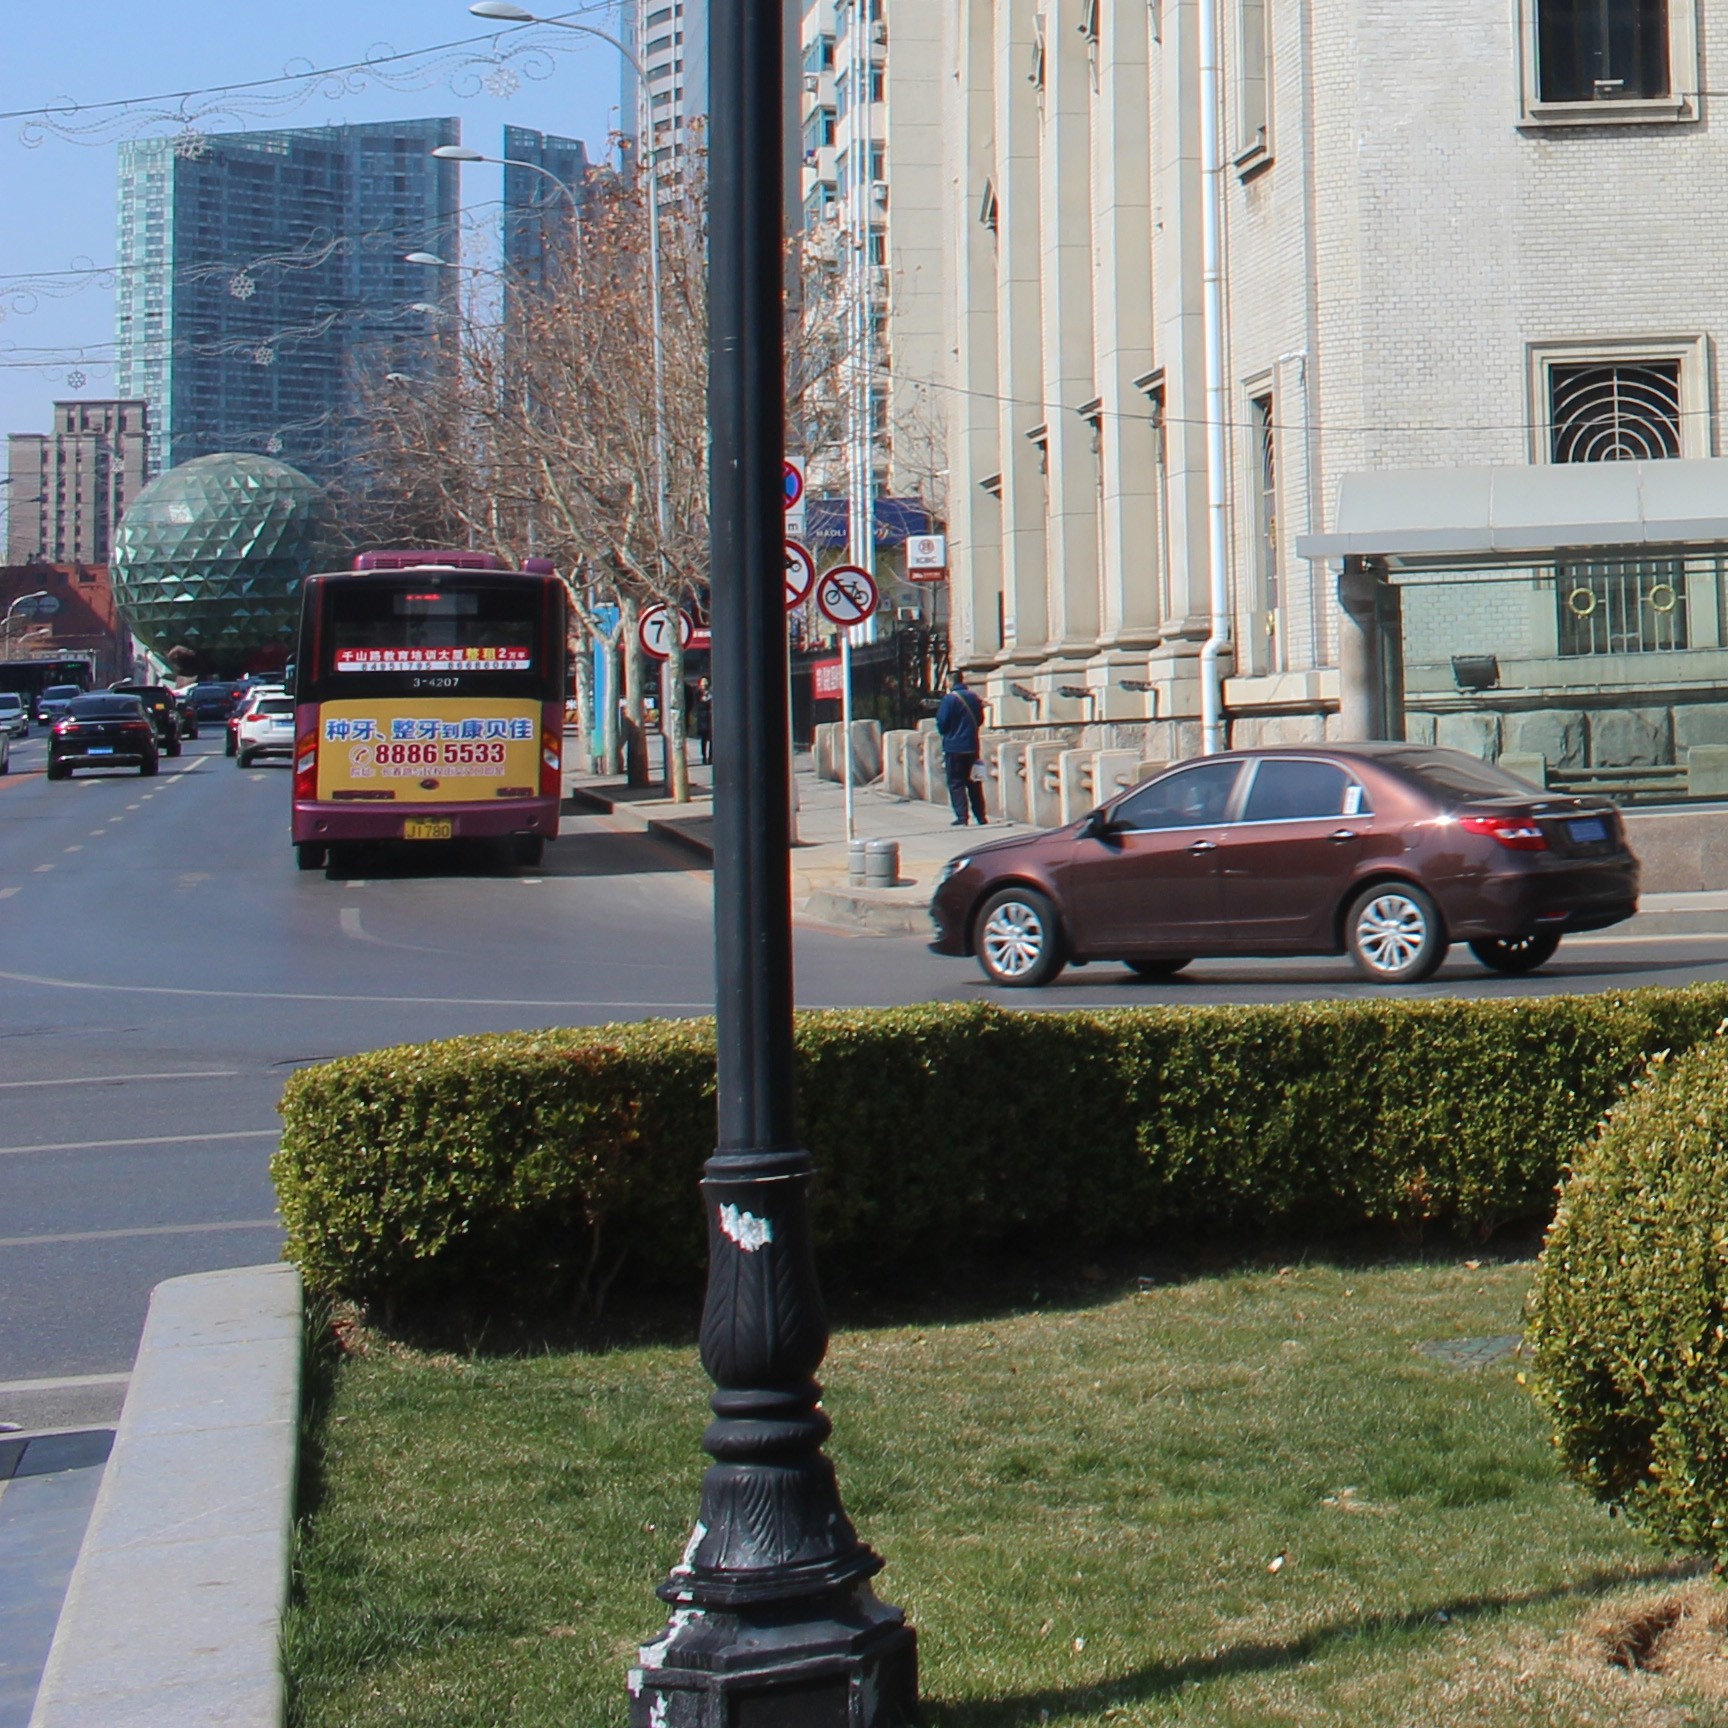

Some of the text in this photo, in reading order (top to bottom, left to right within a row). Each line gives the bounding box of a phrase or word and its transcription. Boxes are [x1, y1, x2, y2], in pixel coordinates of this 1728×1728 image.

[413, 677, 460, 688] 3-4207
[326, 719, 534, 741] 种牙、整牙到康贝佳
[407, 824, 450, 839] J1780
